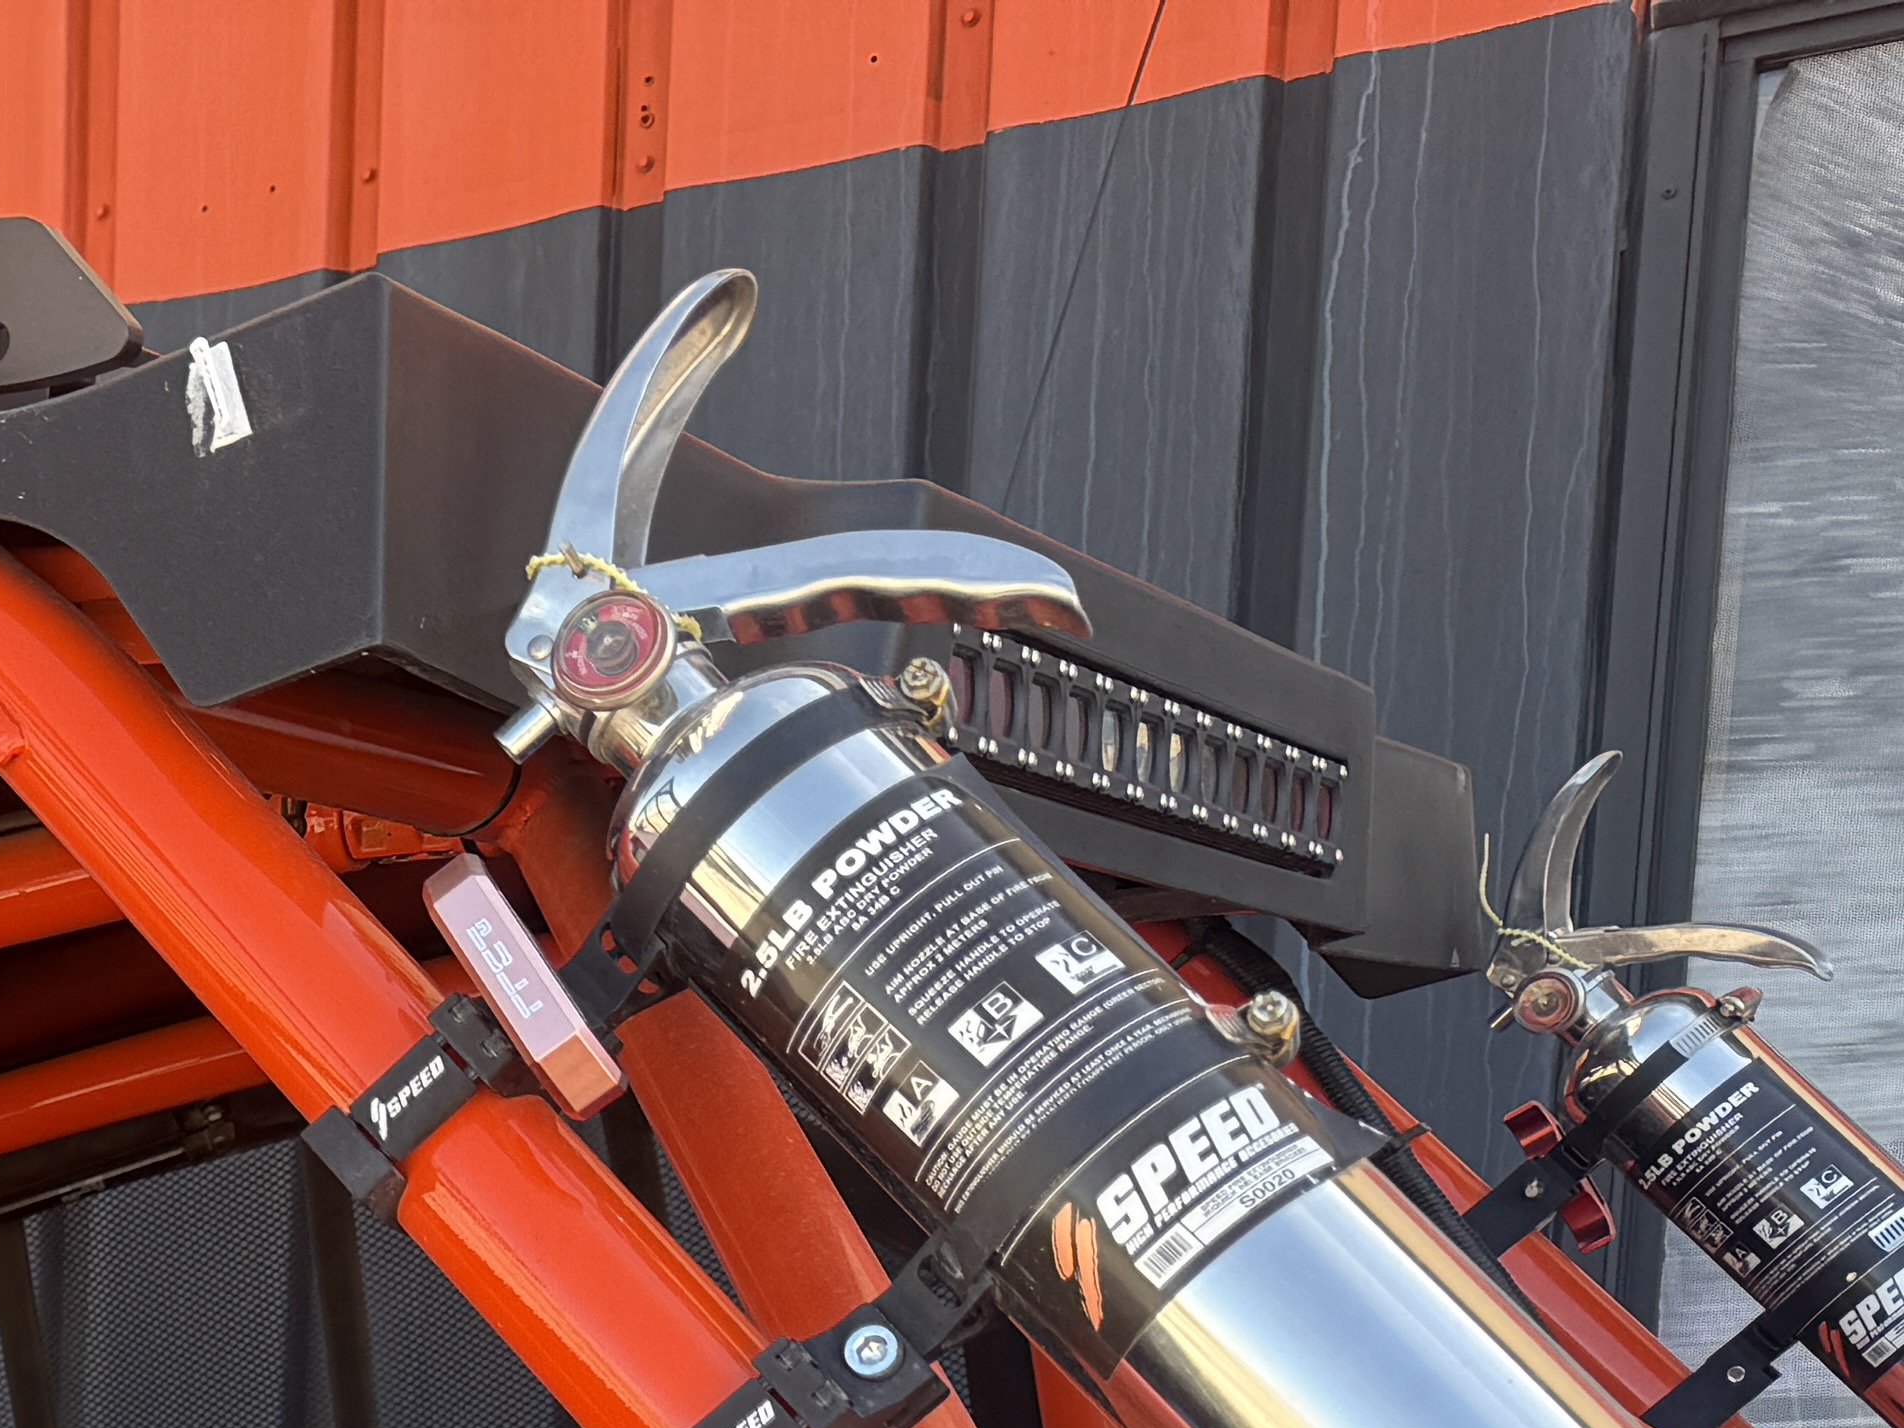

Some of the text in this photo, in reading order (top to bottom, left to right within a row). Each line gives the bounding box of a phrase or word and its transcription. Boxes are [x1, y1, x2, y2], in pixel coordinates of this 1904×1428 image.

[740, 788, 963, 999] 2.5LB POWDER
[784, 827, 938, 971] FIRE EXTINGUISHER
[834, 908, 857, 935] ABC
[856, 885, 882, 913] DRY
[882, 847, 934, 888] POWDER
[864, 865, 1004, 977] USE UPRIGHT, PULL OUT PIN
[885, 972, 905, 995] AIM
[903, 936, 945, 976] NOZZLE
[945, 922, 960, 939] AT
[960, 902, 991, 926] BASE
[990, 891, 1005, 904] OF
[1005, 881, 1030, 897] FIRE
[893, 960, 936, 1003] APPROX
[943, 919, 989, 957] METERS
[907, 900, 1061, 1017] SQUEEZE HANDLE TO OPERATE
[915, 917, 1051, 1026] RELEASE HANDLE TO STOP
[1071, 937, 1097, 957] C
[981, 992, 1013, 1021] B
[385, 1054, 448, 1119] SPEED
[994, 1049, 1058, 1111] TEMPERATURE
[1018, 1028, 1071, 1076] OPERATING
[910, 1075, 933, 1100] A
[1672, 1081, 1760, 1155] POWDER
[1096, 1086, 1281, 1246] SPEED
[1154, 1161, 1238, 1228] PERFORMANCE
[1239, 1168, 1296, 1208] S0020
[1821, 1170, 1838, 1185] C
[1771, 1209, 1788, 1226] B
